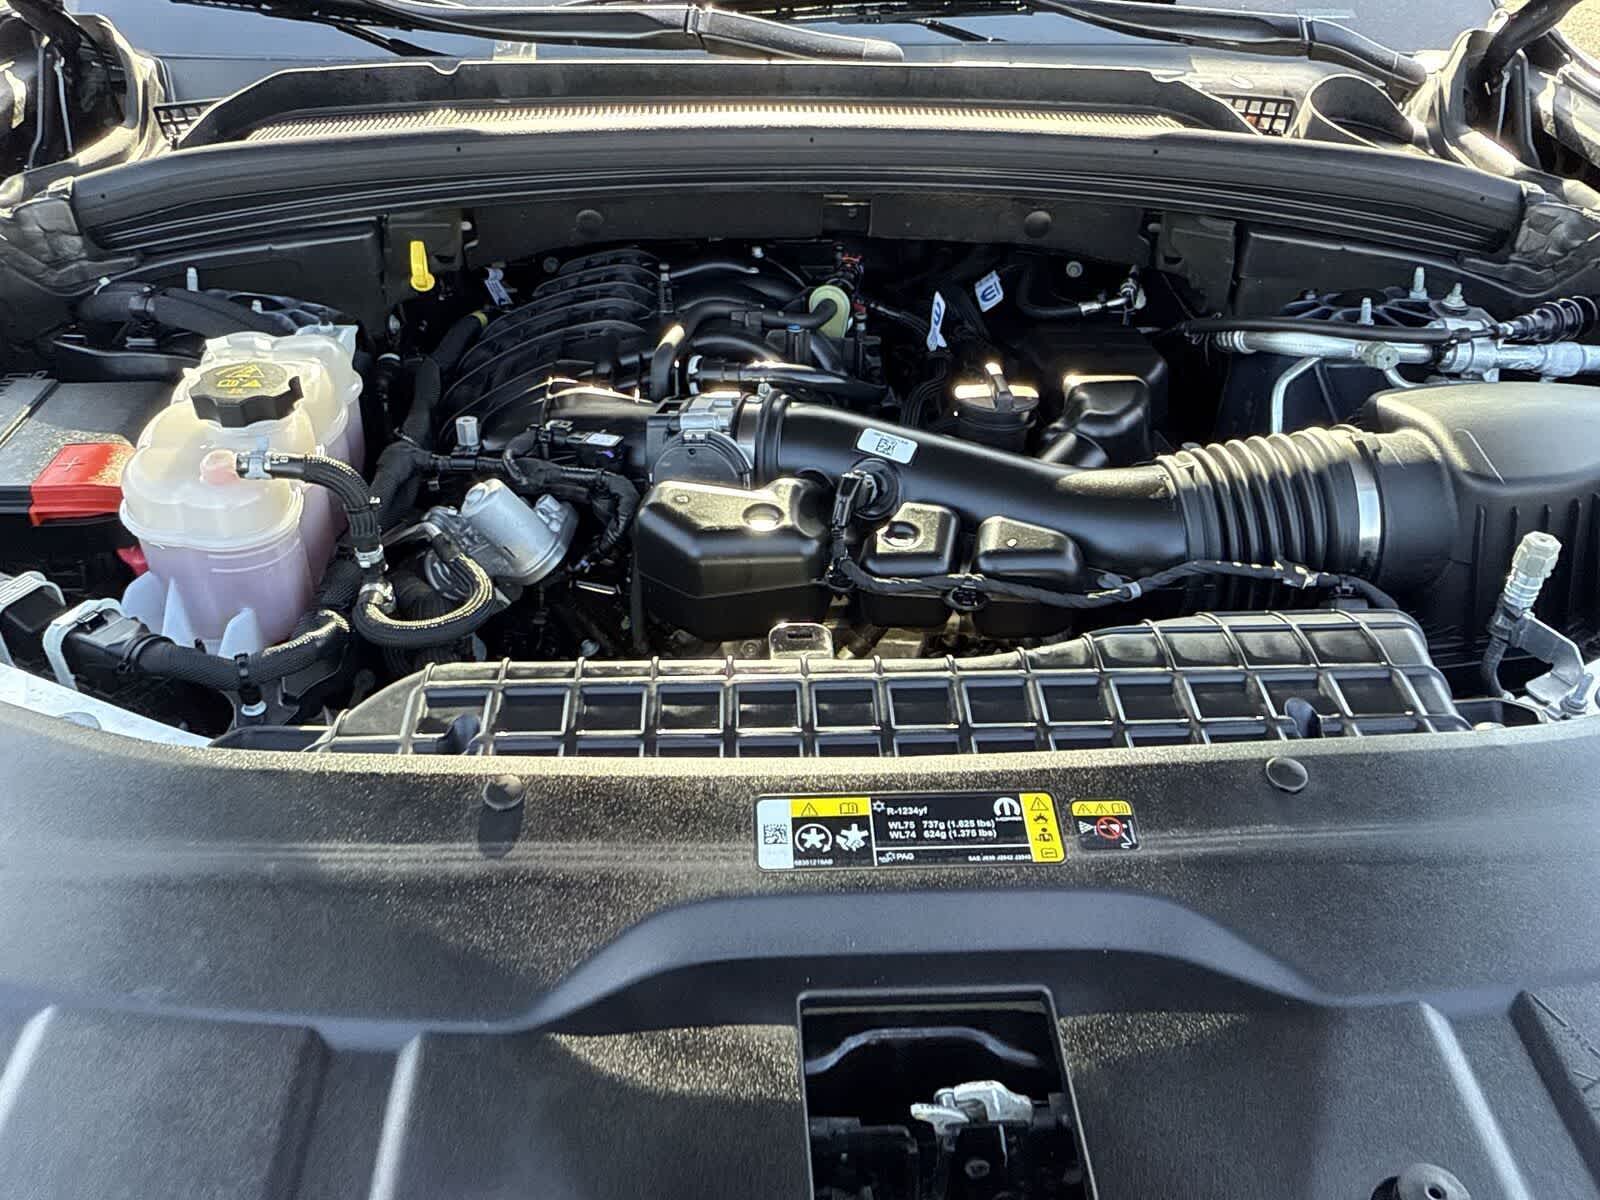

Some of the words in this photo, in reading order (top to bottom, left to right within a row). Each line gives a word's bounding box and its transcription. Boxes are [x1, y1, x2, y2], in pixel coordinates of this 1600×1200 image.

[886, 806, 928, 816] R-1234yf
[888, 820, 916, 830] WL75
[922, 820, 946, 830] 737g
[976, 818, 996, 829] lbs)
[889, 830, 917, 840] WL74
[923, 829, 947, 840] 624g
[978, 829, 997, 839] lbs)
